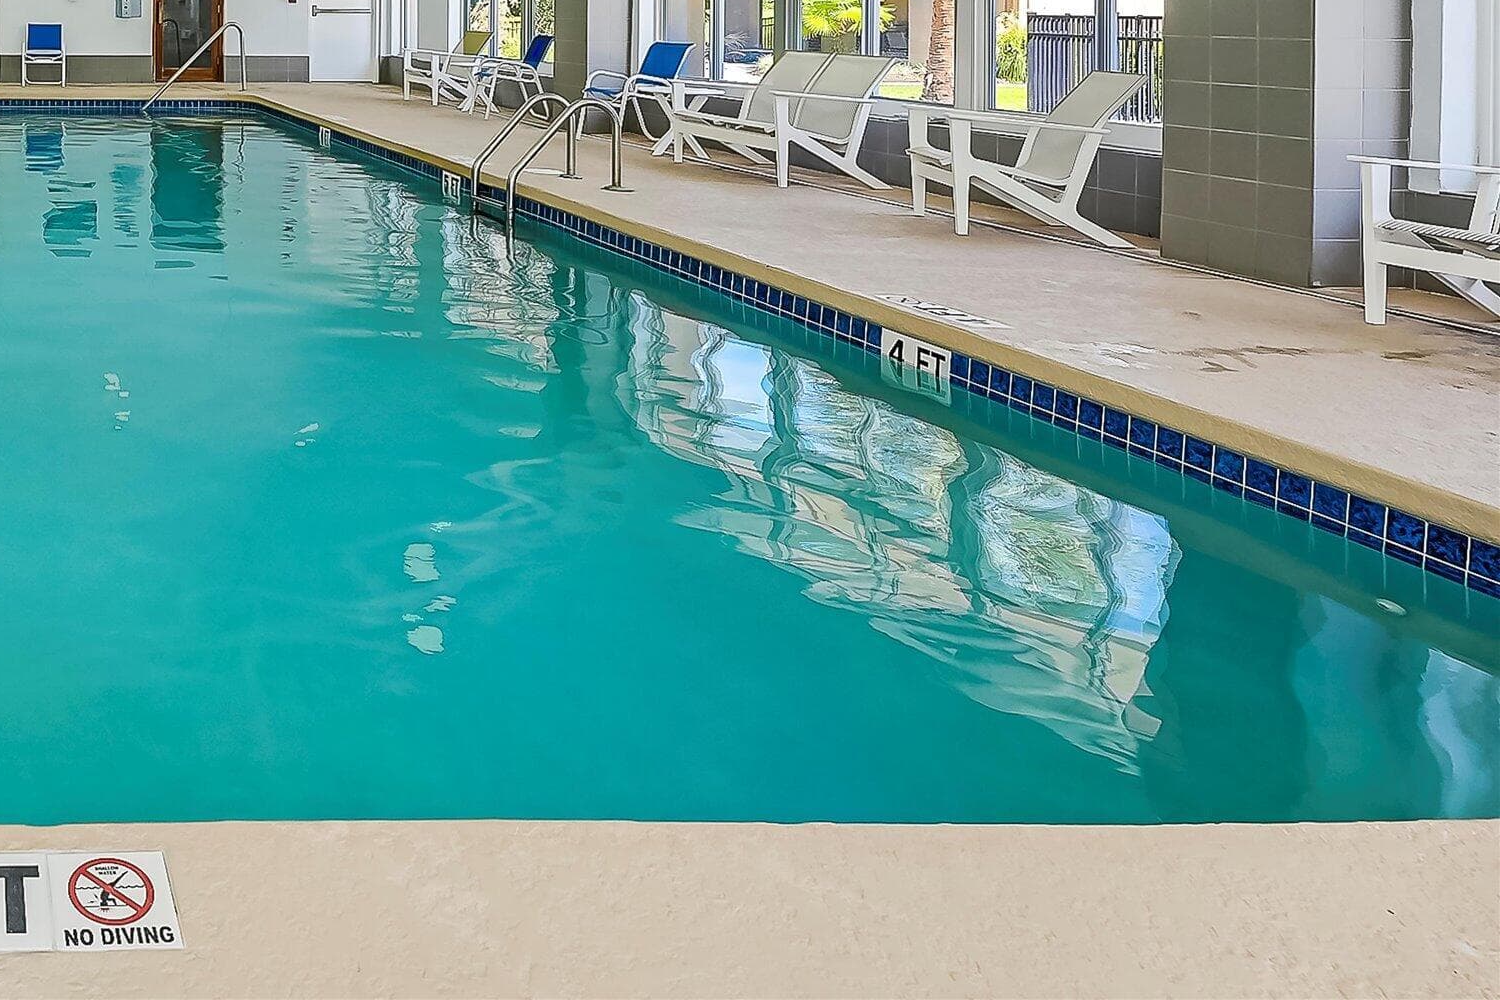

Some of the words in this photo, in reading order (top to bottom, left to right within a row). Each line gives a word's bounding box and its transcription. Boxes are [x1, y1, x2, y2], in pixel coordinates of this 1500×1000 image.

[888, 338, 905, 363] 4
[916, 346, 946, 379] FT
[64, 929, 94, 947] NO
[100, 926, 175, 946] DIVING
